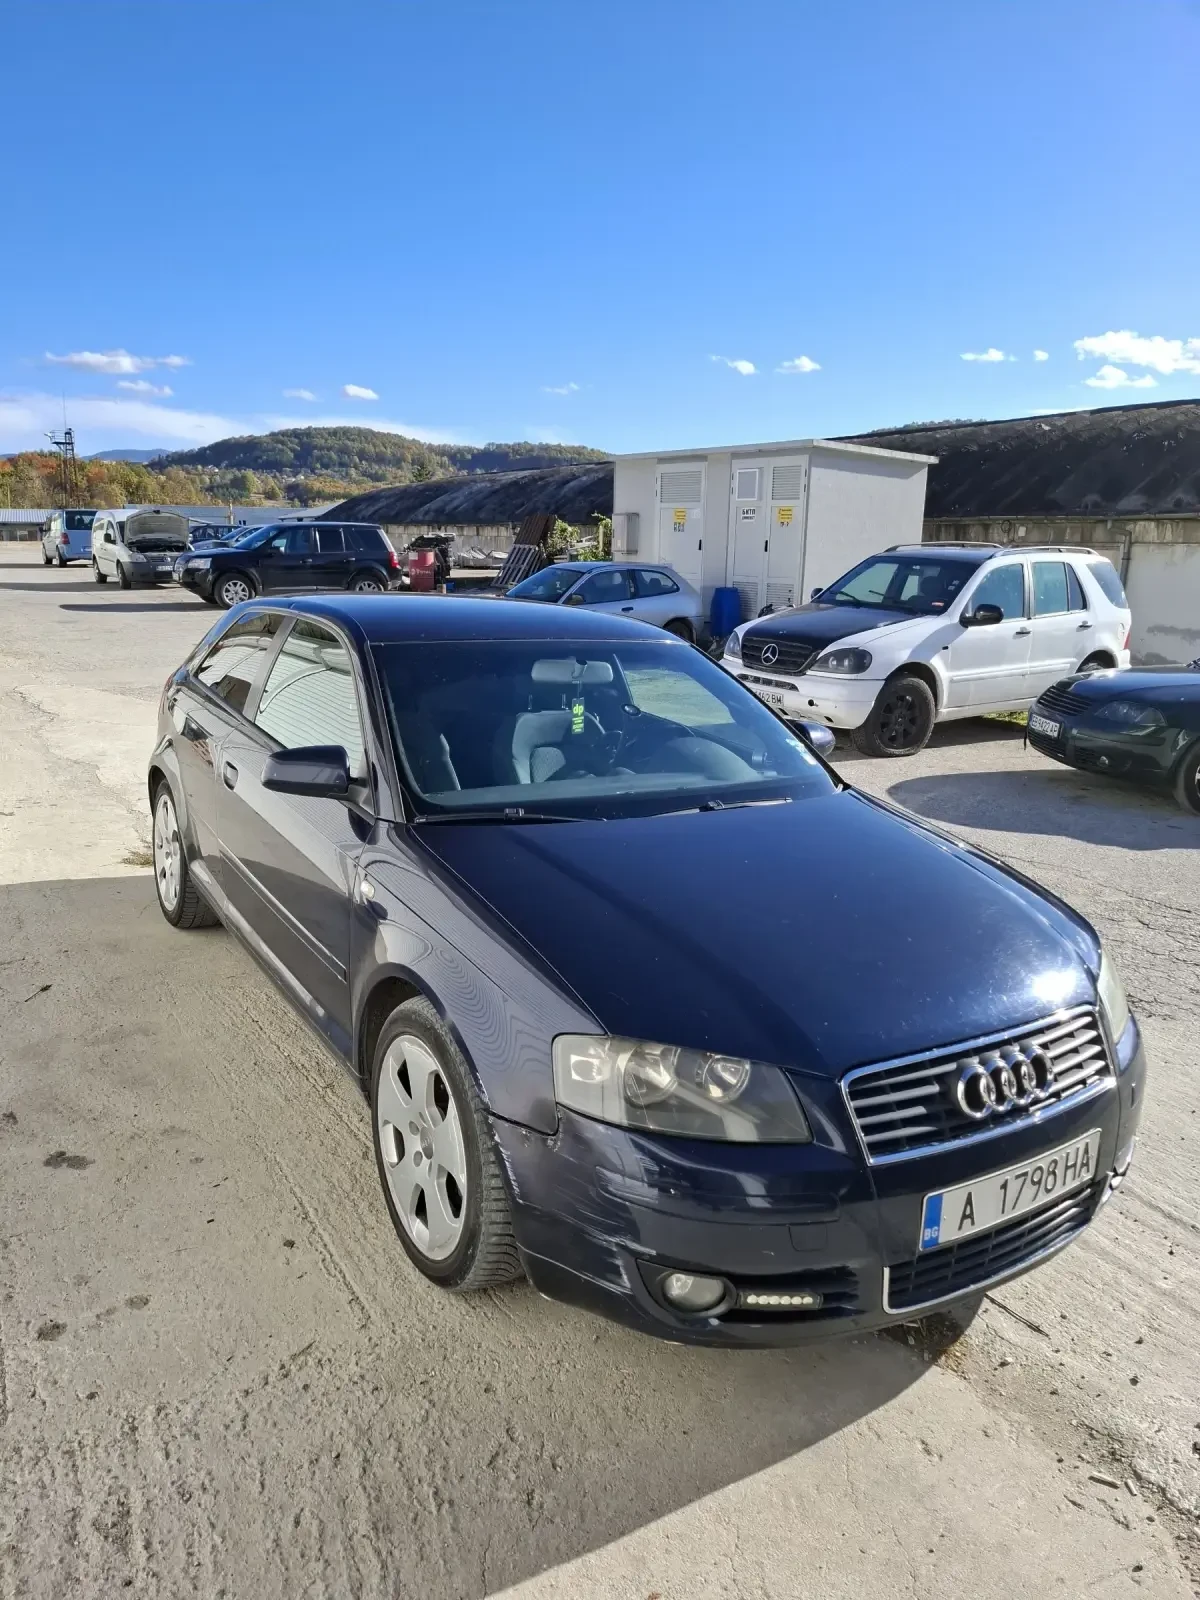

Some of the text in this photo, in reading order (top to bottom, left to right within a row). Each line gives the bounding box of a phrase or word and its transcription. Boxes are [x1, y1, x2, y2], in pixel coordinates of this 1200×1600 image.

[573, 703, 584, 716] dp
[957, 1191, 975, 1231] A
[923, 1226, 939, 1241] BG
